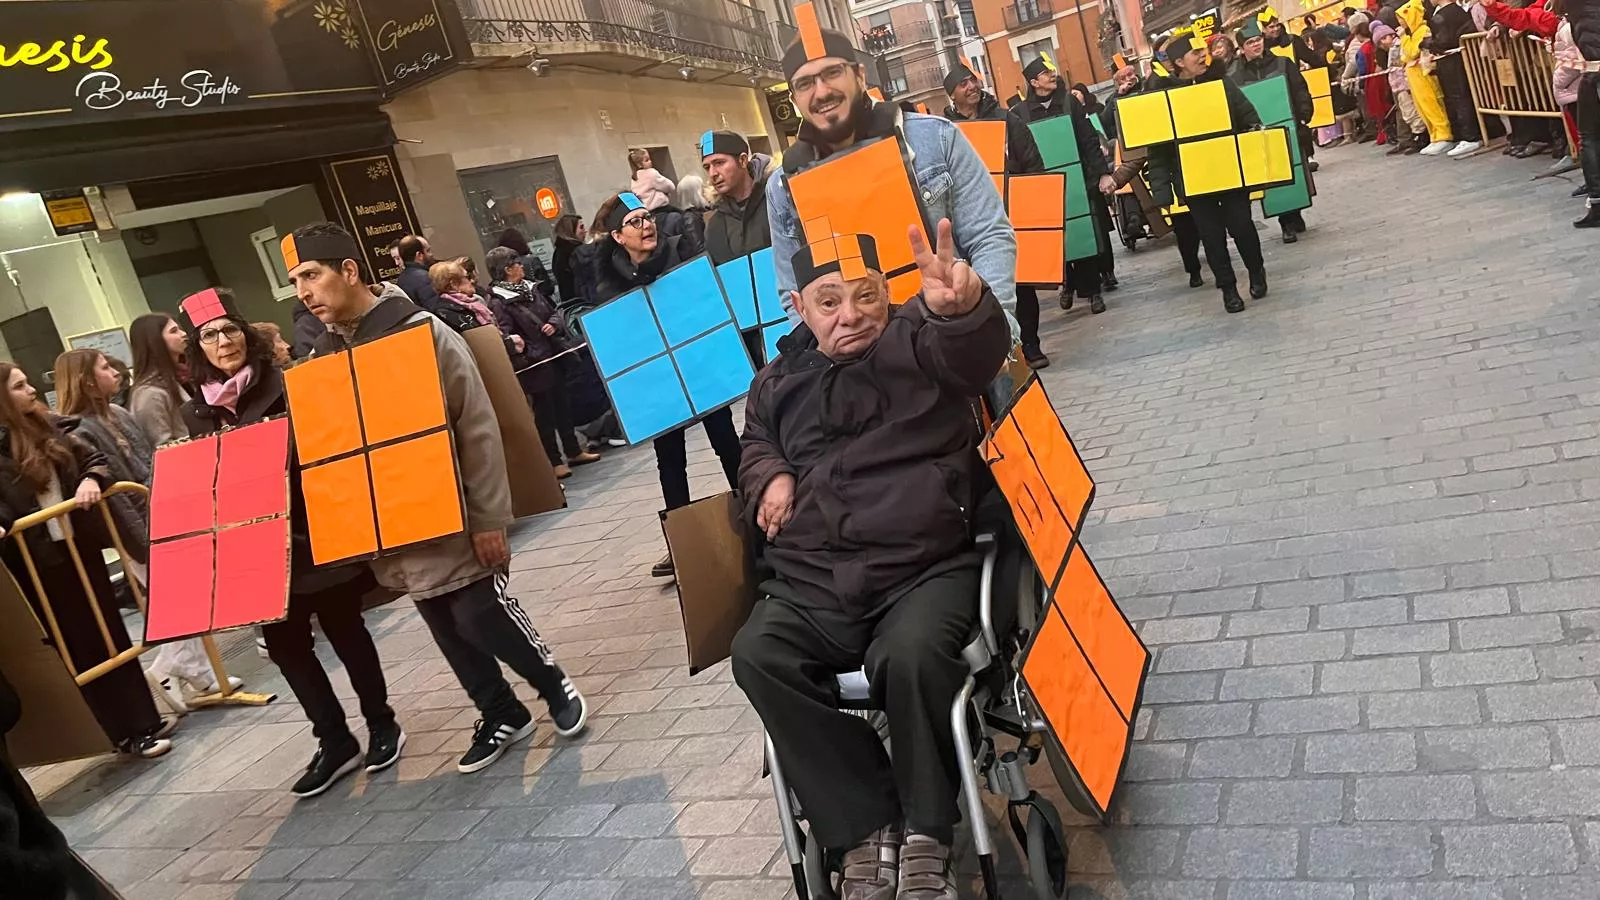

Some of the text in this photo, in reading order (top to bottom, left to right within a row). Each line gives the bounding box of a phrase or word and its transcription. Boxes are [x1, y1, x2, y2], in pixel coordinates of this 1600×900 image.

[75, 69, 241, 109] Beauty Studio
[355, 200, 398, 216] Maquillaje
[365, 222, 403, 236] Manicura
[374, 245, 391, 257] Ped
[378, 266, 402, 278] Esma
